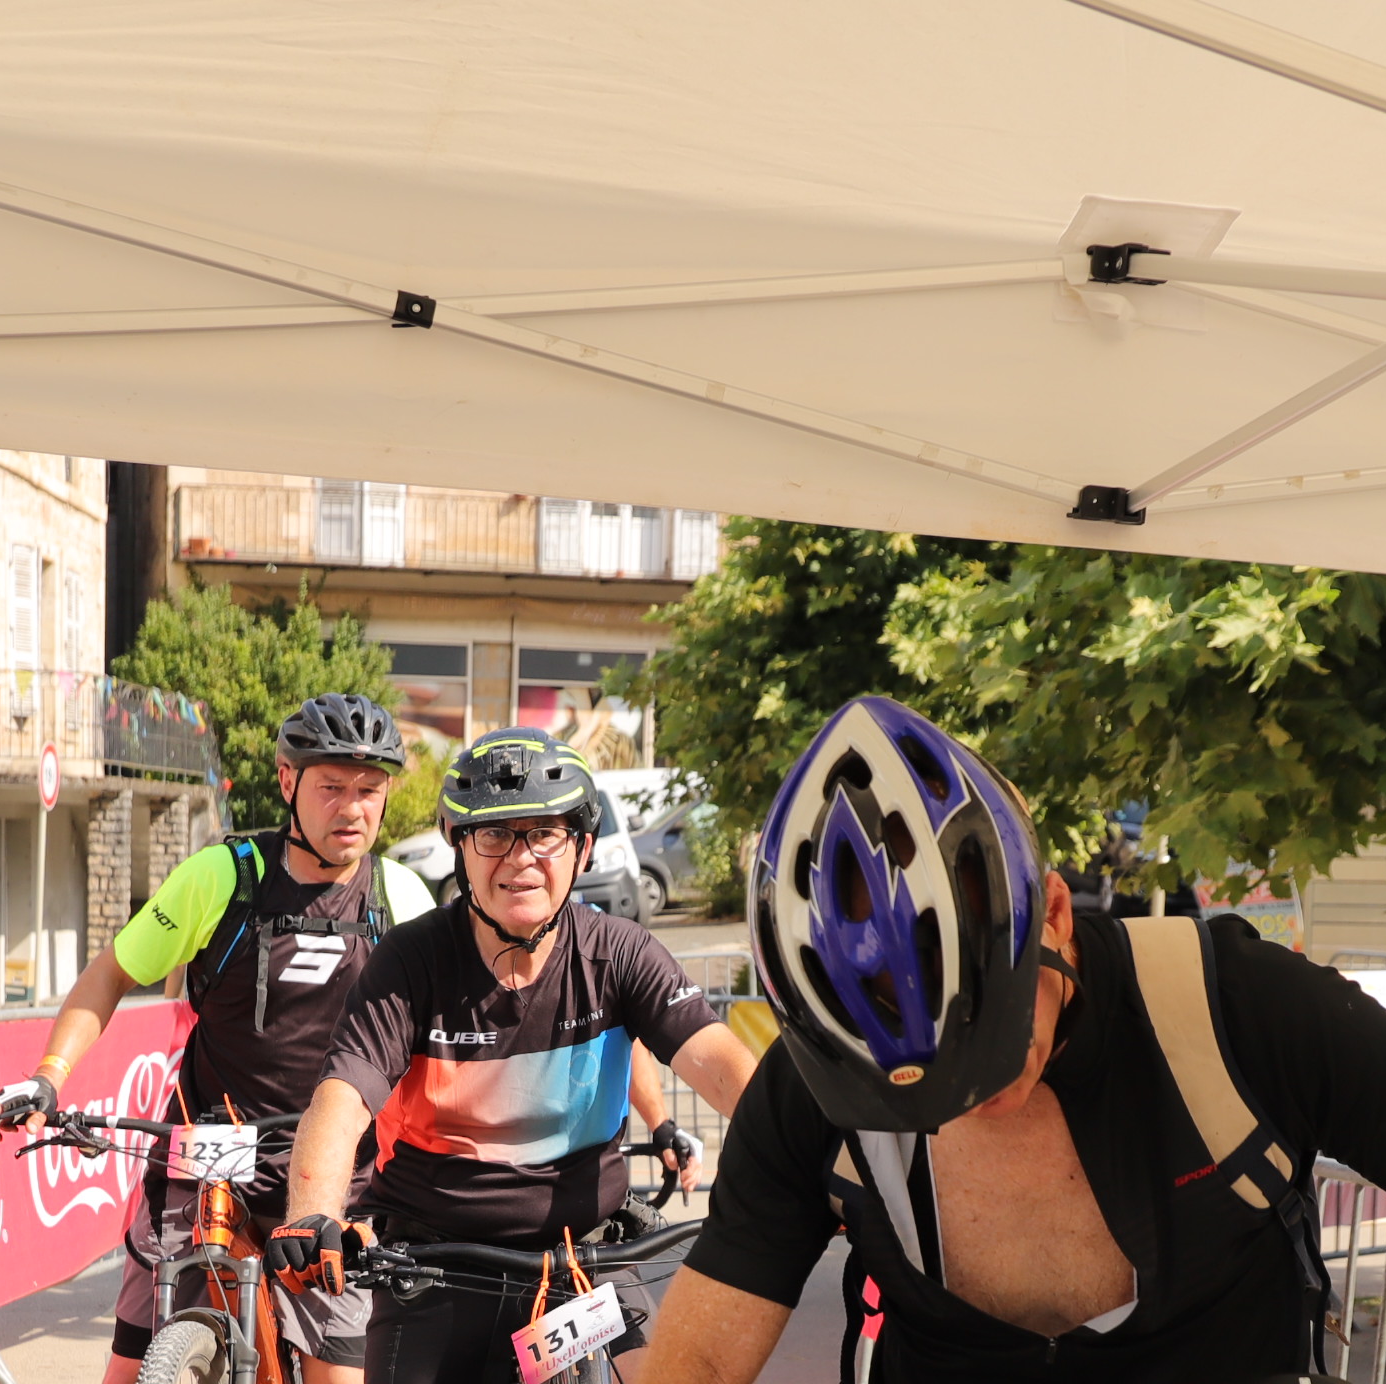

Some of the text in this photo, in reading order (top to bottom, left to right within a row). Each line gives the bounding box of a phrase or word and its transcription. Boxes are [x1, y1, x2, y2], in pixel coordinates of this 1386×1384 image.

[893, 1069, 921, 1082] BELL
[178, 1141, 224, 1161] 123
[526, 1319, 580, 1363] 131
